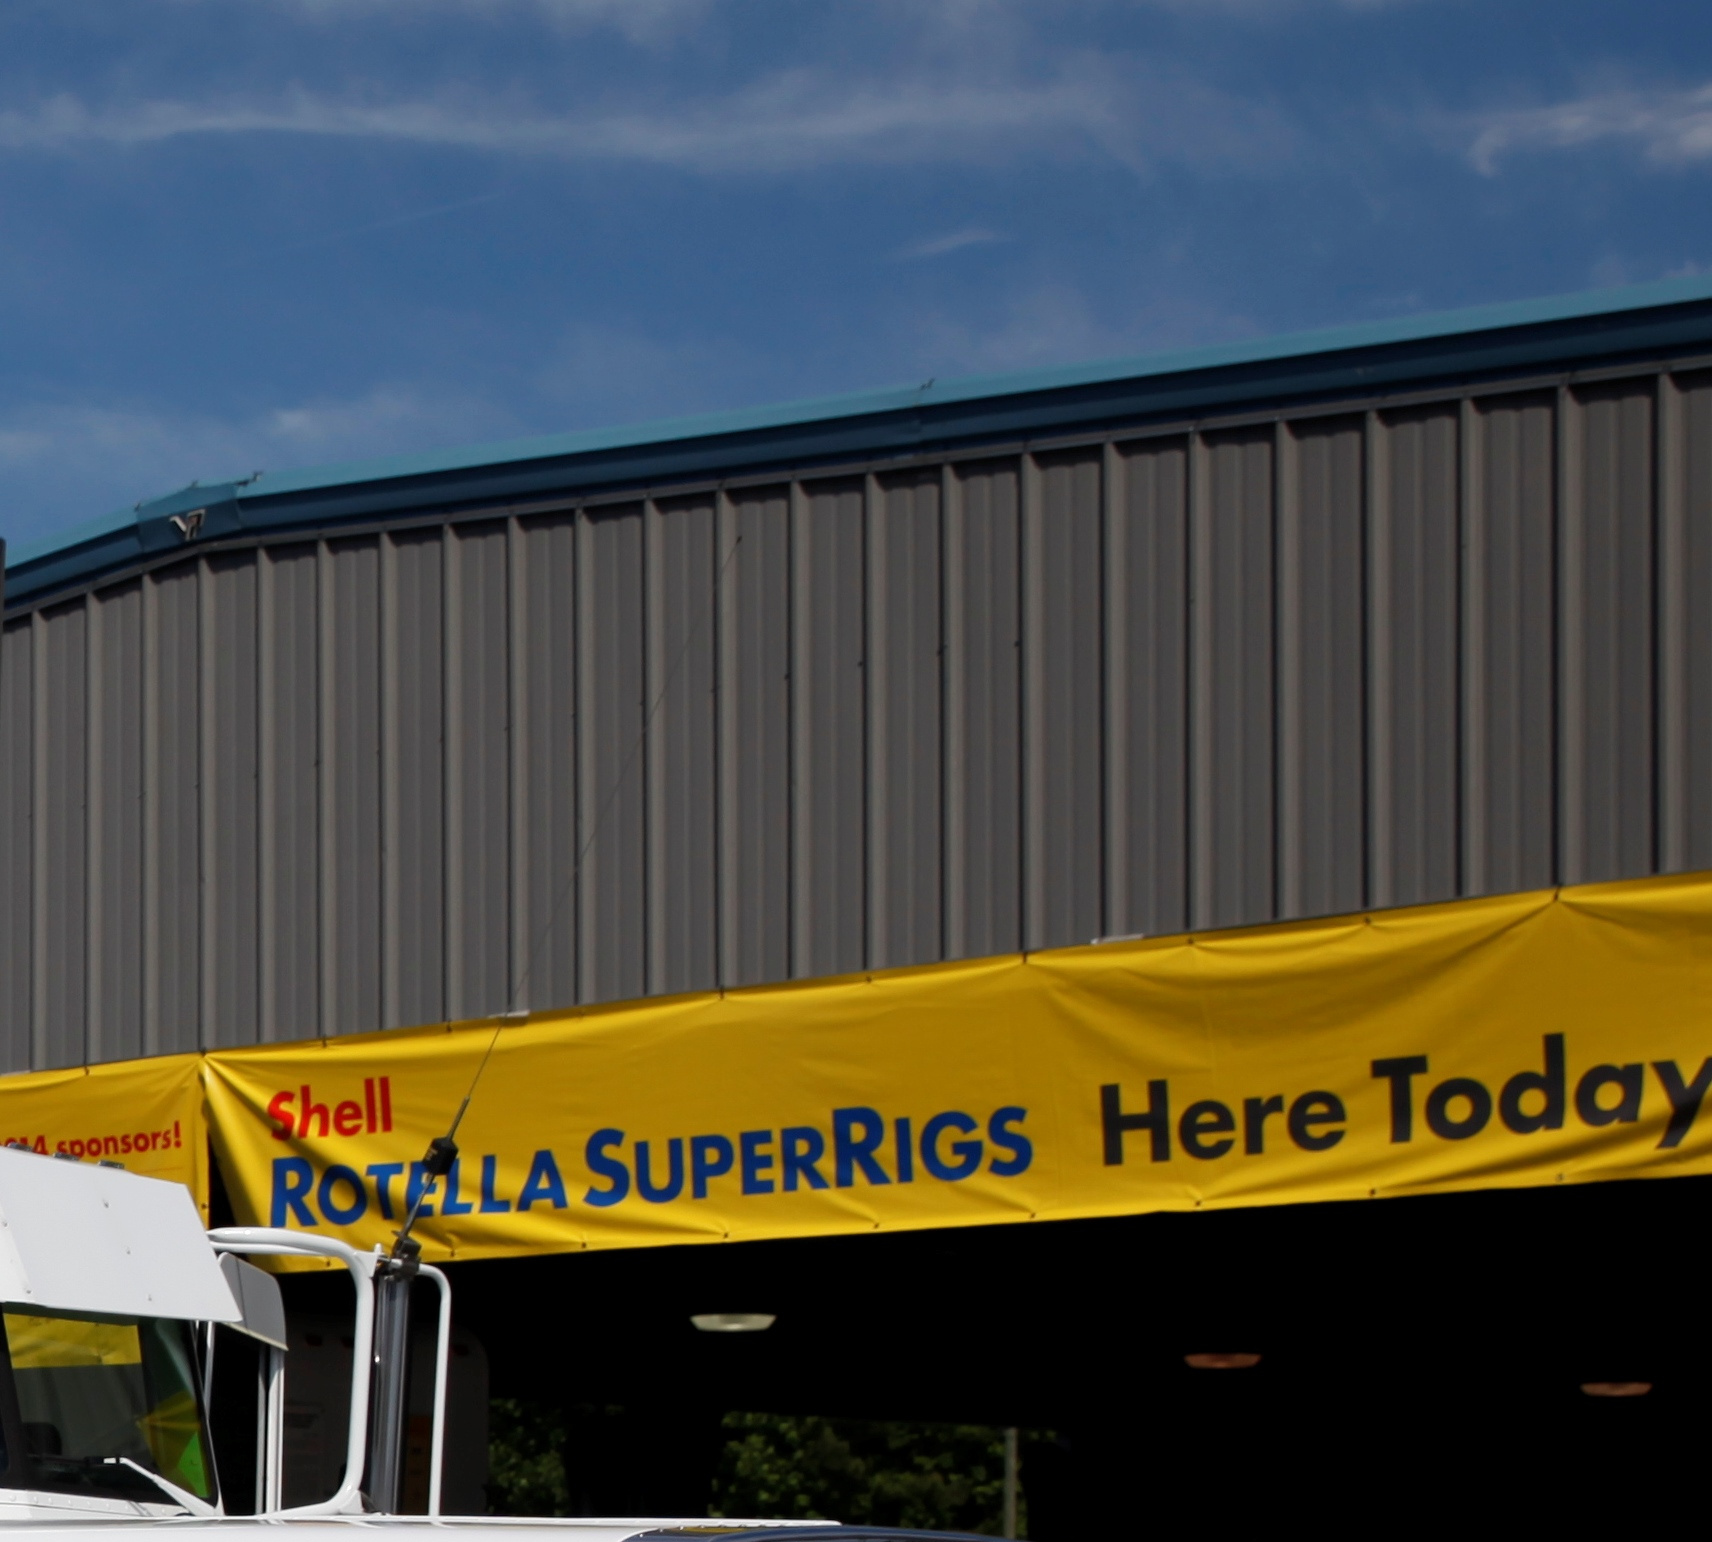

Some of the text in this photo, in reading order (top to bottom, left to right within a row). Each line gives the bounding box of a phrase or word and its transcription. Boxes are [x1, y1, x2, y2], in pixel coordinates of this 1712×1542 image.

[56, 1119, 183, 1159] sponsors!
[267, 1076, 392, 1140] Shell
[270, 1148, 569, 1229] ROTELLA
[1099, 1077, 1348, 1167] Here
[1369, 1031, 1712, 1149] Today
